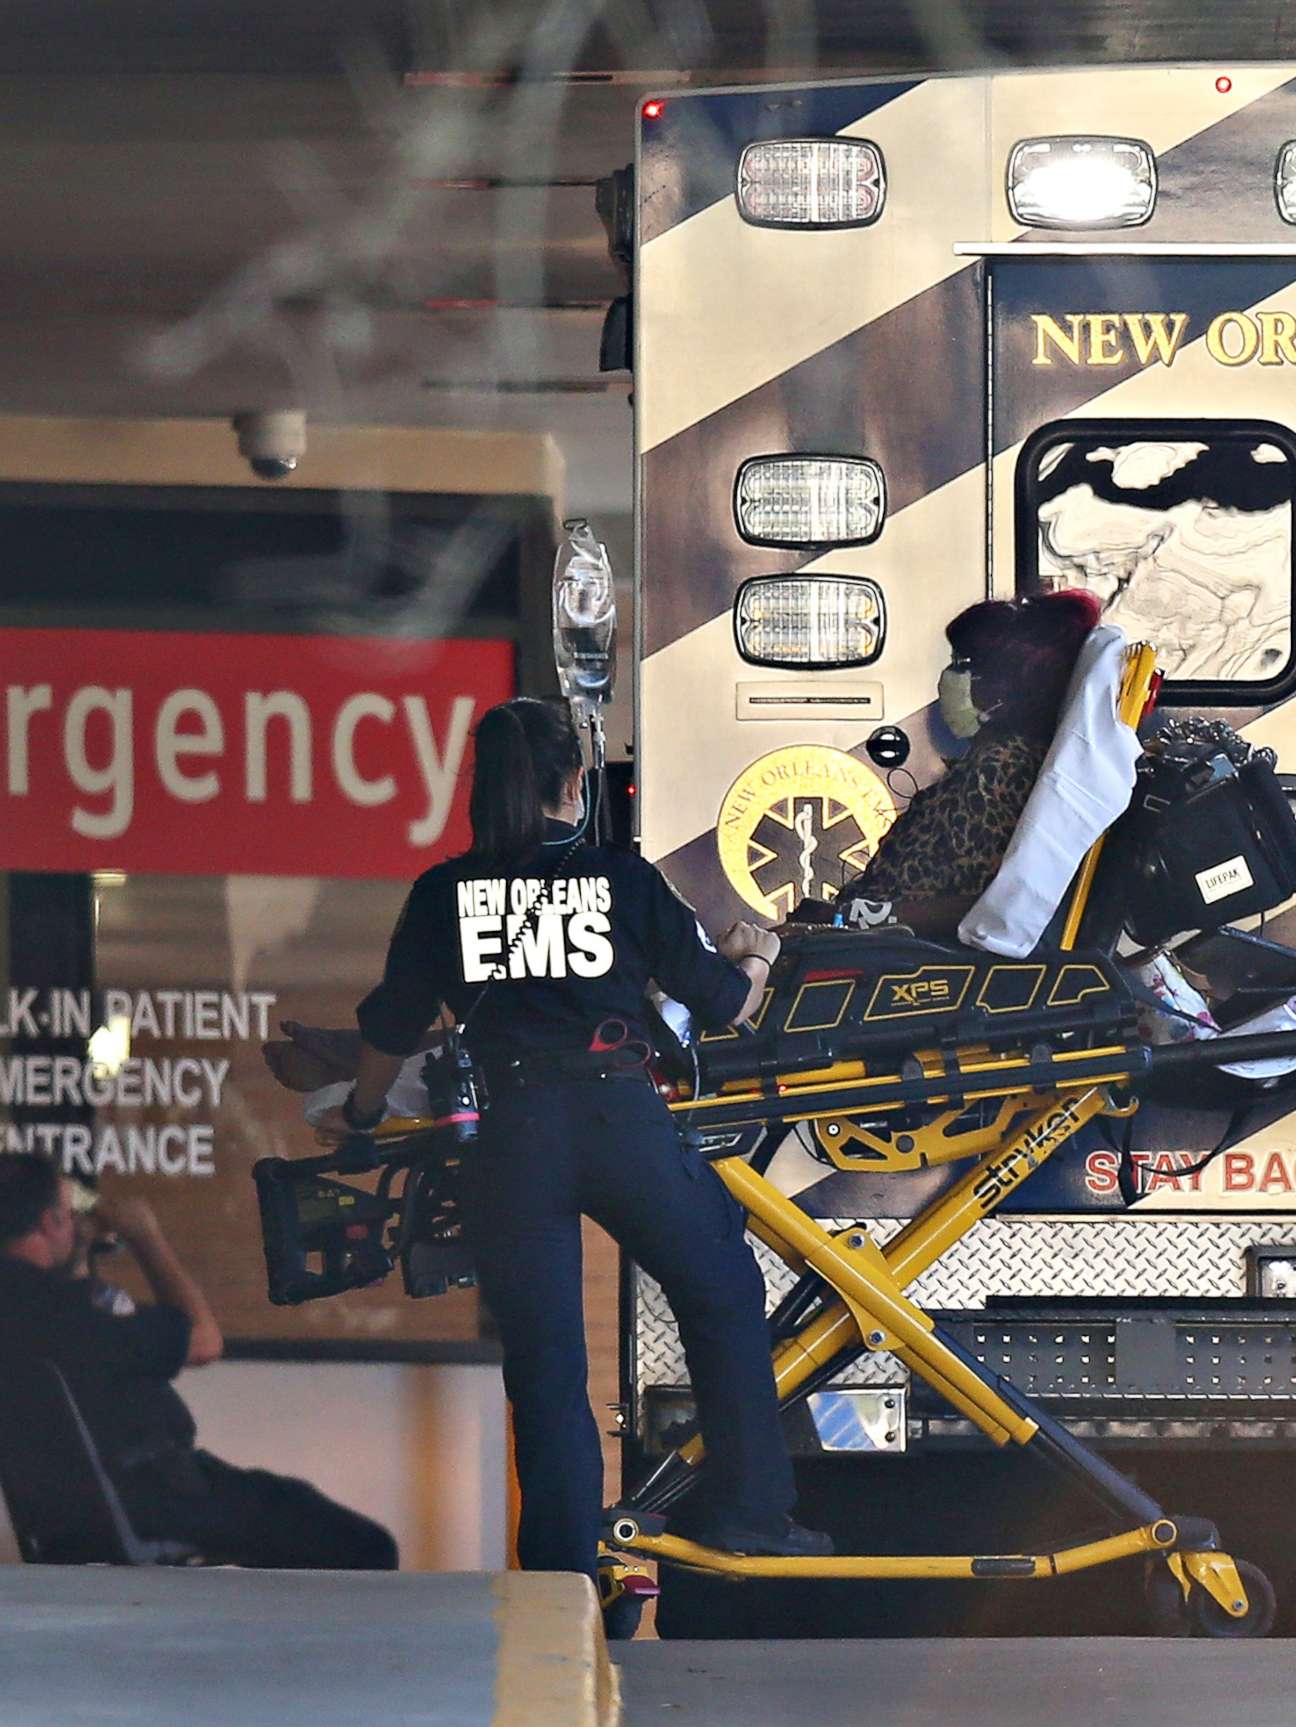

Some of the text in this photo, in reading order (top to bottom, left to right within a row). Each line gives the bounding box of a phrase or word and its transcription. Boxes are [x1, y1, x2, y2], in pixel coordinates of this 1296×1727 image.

[1031, 310, 1190, 367] NEW
[6, 683, 477, 848] rgency
[760, 760, 858, 789] ORLEANS
[457, 876, 612, 918] NEW ORLEANS
[460, 911, 614, 983] EMS
[105, 989, 277, 1042] PATIENT
[890, 979, 950, 1006] XPS
[1085, 1151, 1213, 1194] STAY
